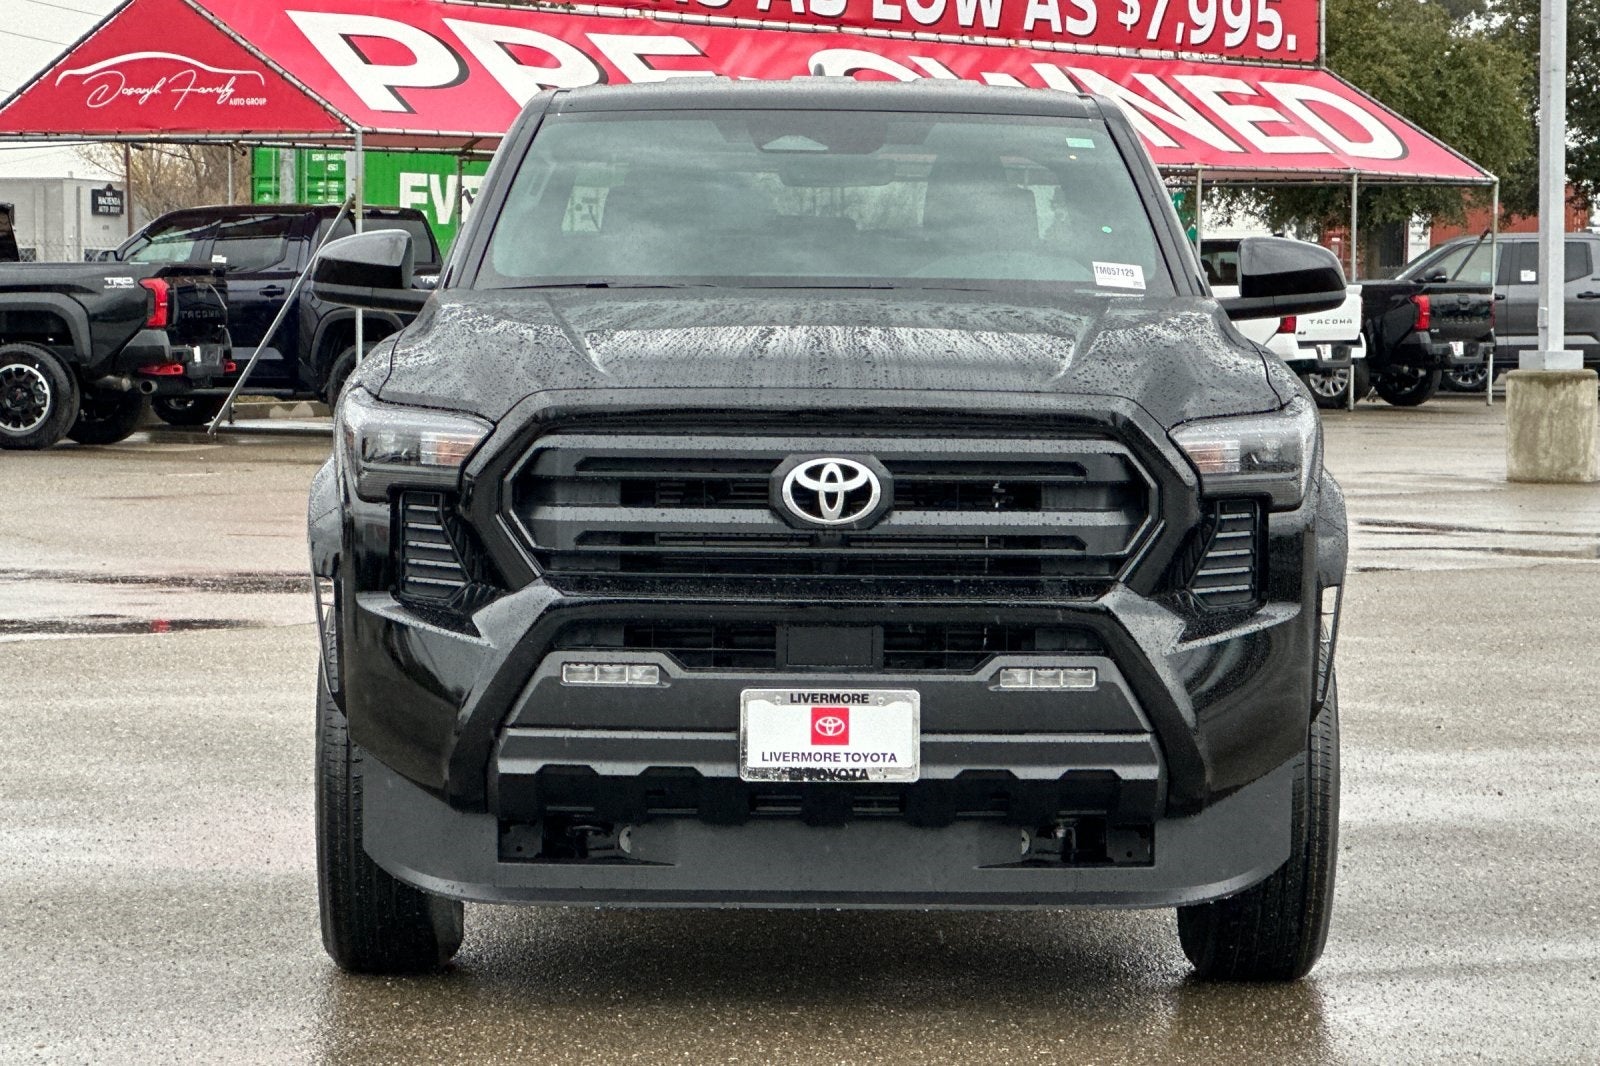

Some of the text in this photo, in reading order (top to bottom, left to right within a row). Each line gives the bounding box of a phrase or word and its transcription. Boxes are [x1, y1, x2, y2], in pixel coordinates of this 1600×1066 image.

[1024, 0, 1097, 36] AS
[169, 69, 236, 110] Family
[229, 98, 267, 106] AUTO GROUP
[104, 276, 134, 286] TRD
[790, 693, 869, 704] LIVERMORE
[762, 751, 898, 763] LIVERMORE TOYOTA
